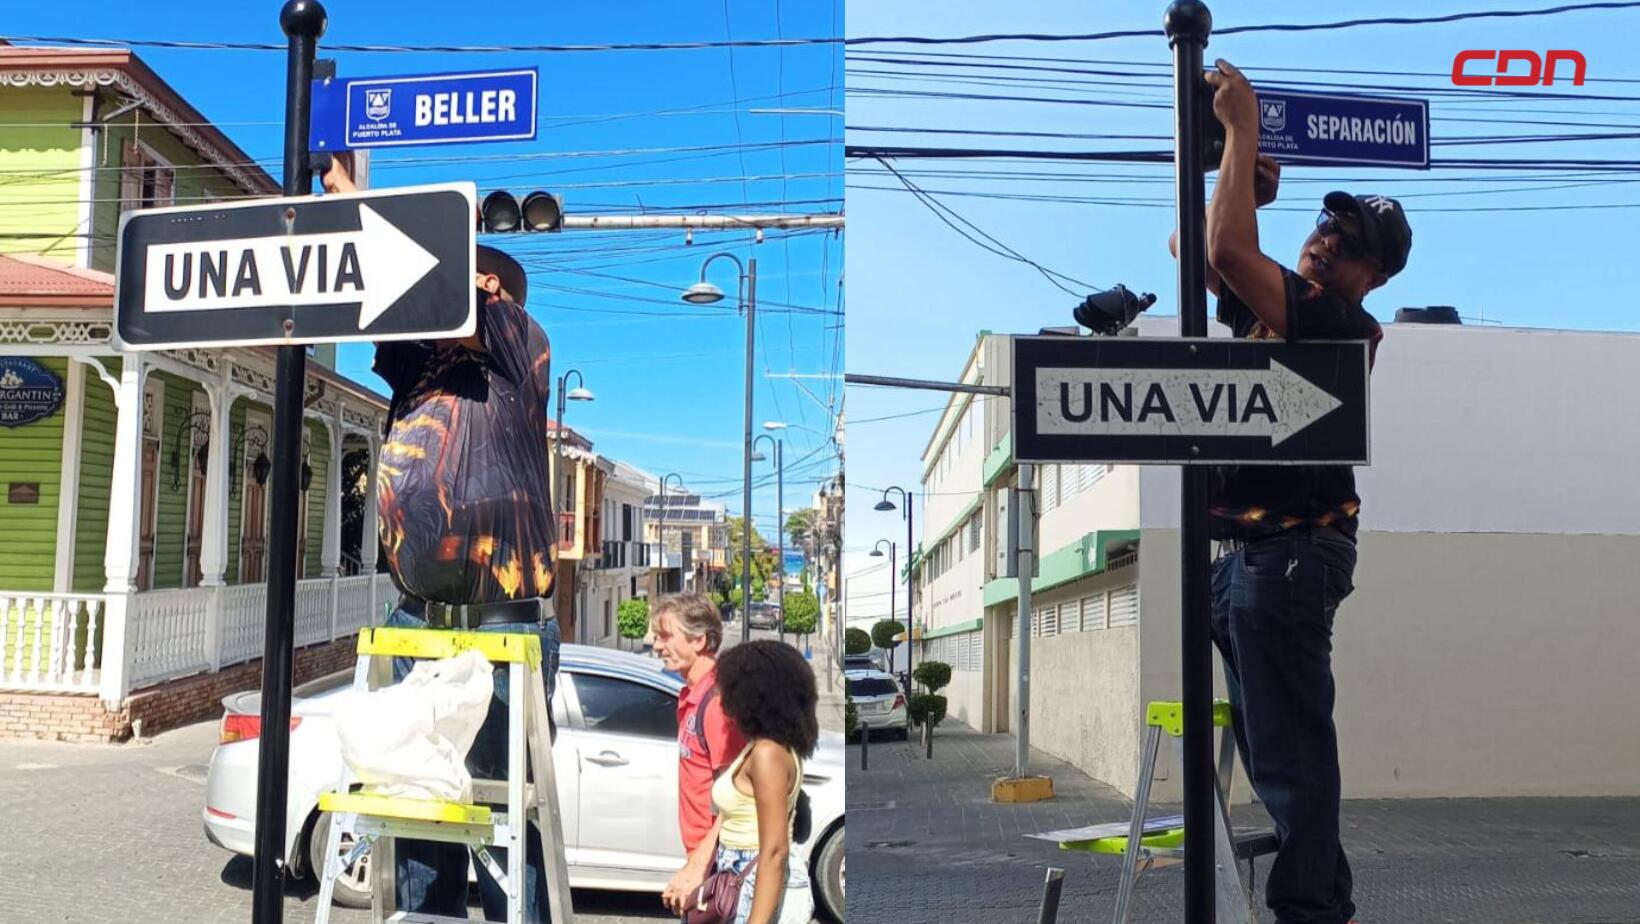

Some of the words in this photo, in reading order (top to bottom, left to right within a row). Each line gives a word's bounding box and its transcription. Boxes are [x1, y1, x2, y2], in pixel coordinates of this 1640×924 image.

[414, 89, 517, 128] BELLER
[352, 130, 380, 138] PUERTO
[381, 129, 402, 137] PLATA
[1277, 141, 1299, 150] PLATA
[1306, 112, 1416, 146] SEPARACIÓN
[164, 248, 262, 301] UNA
[280, 241, 365, 295] VIA
[1, 411, 20, 421] BAR
[1060, 382, 1176, 424] UNA
[1188, 383, 1278, 424] VIA
